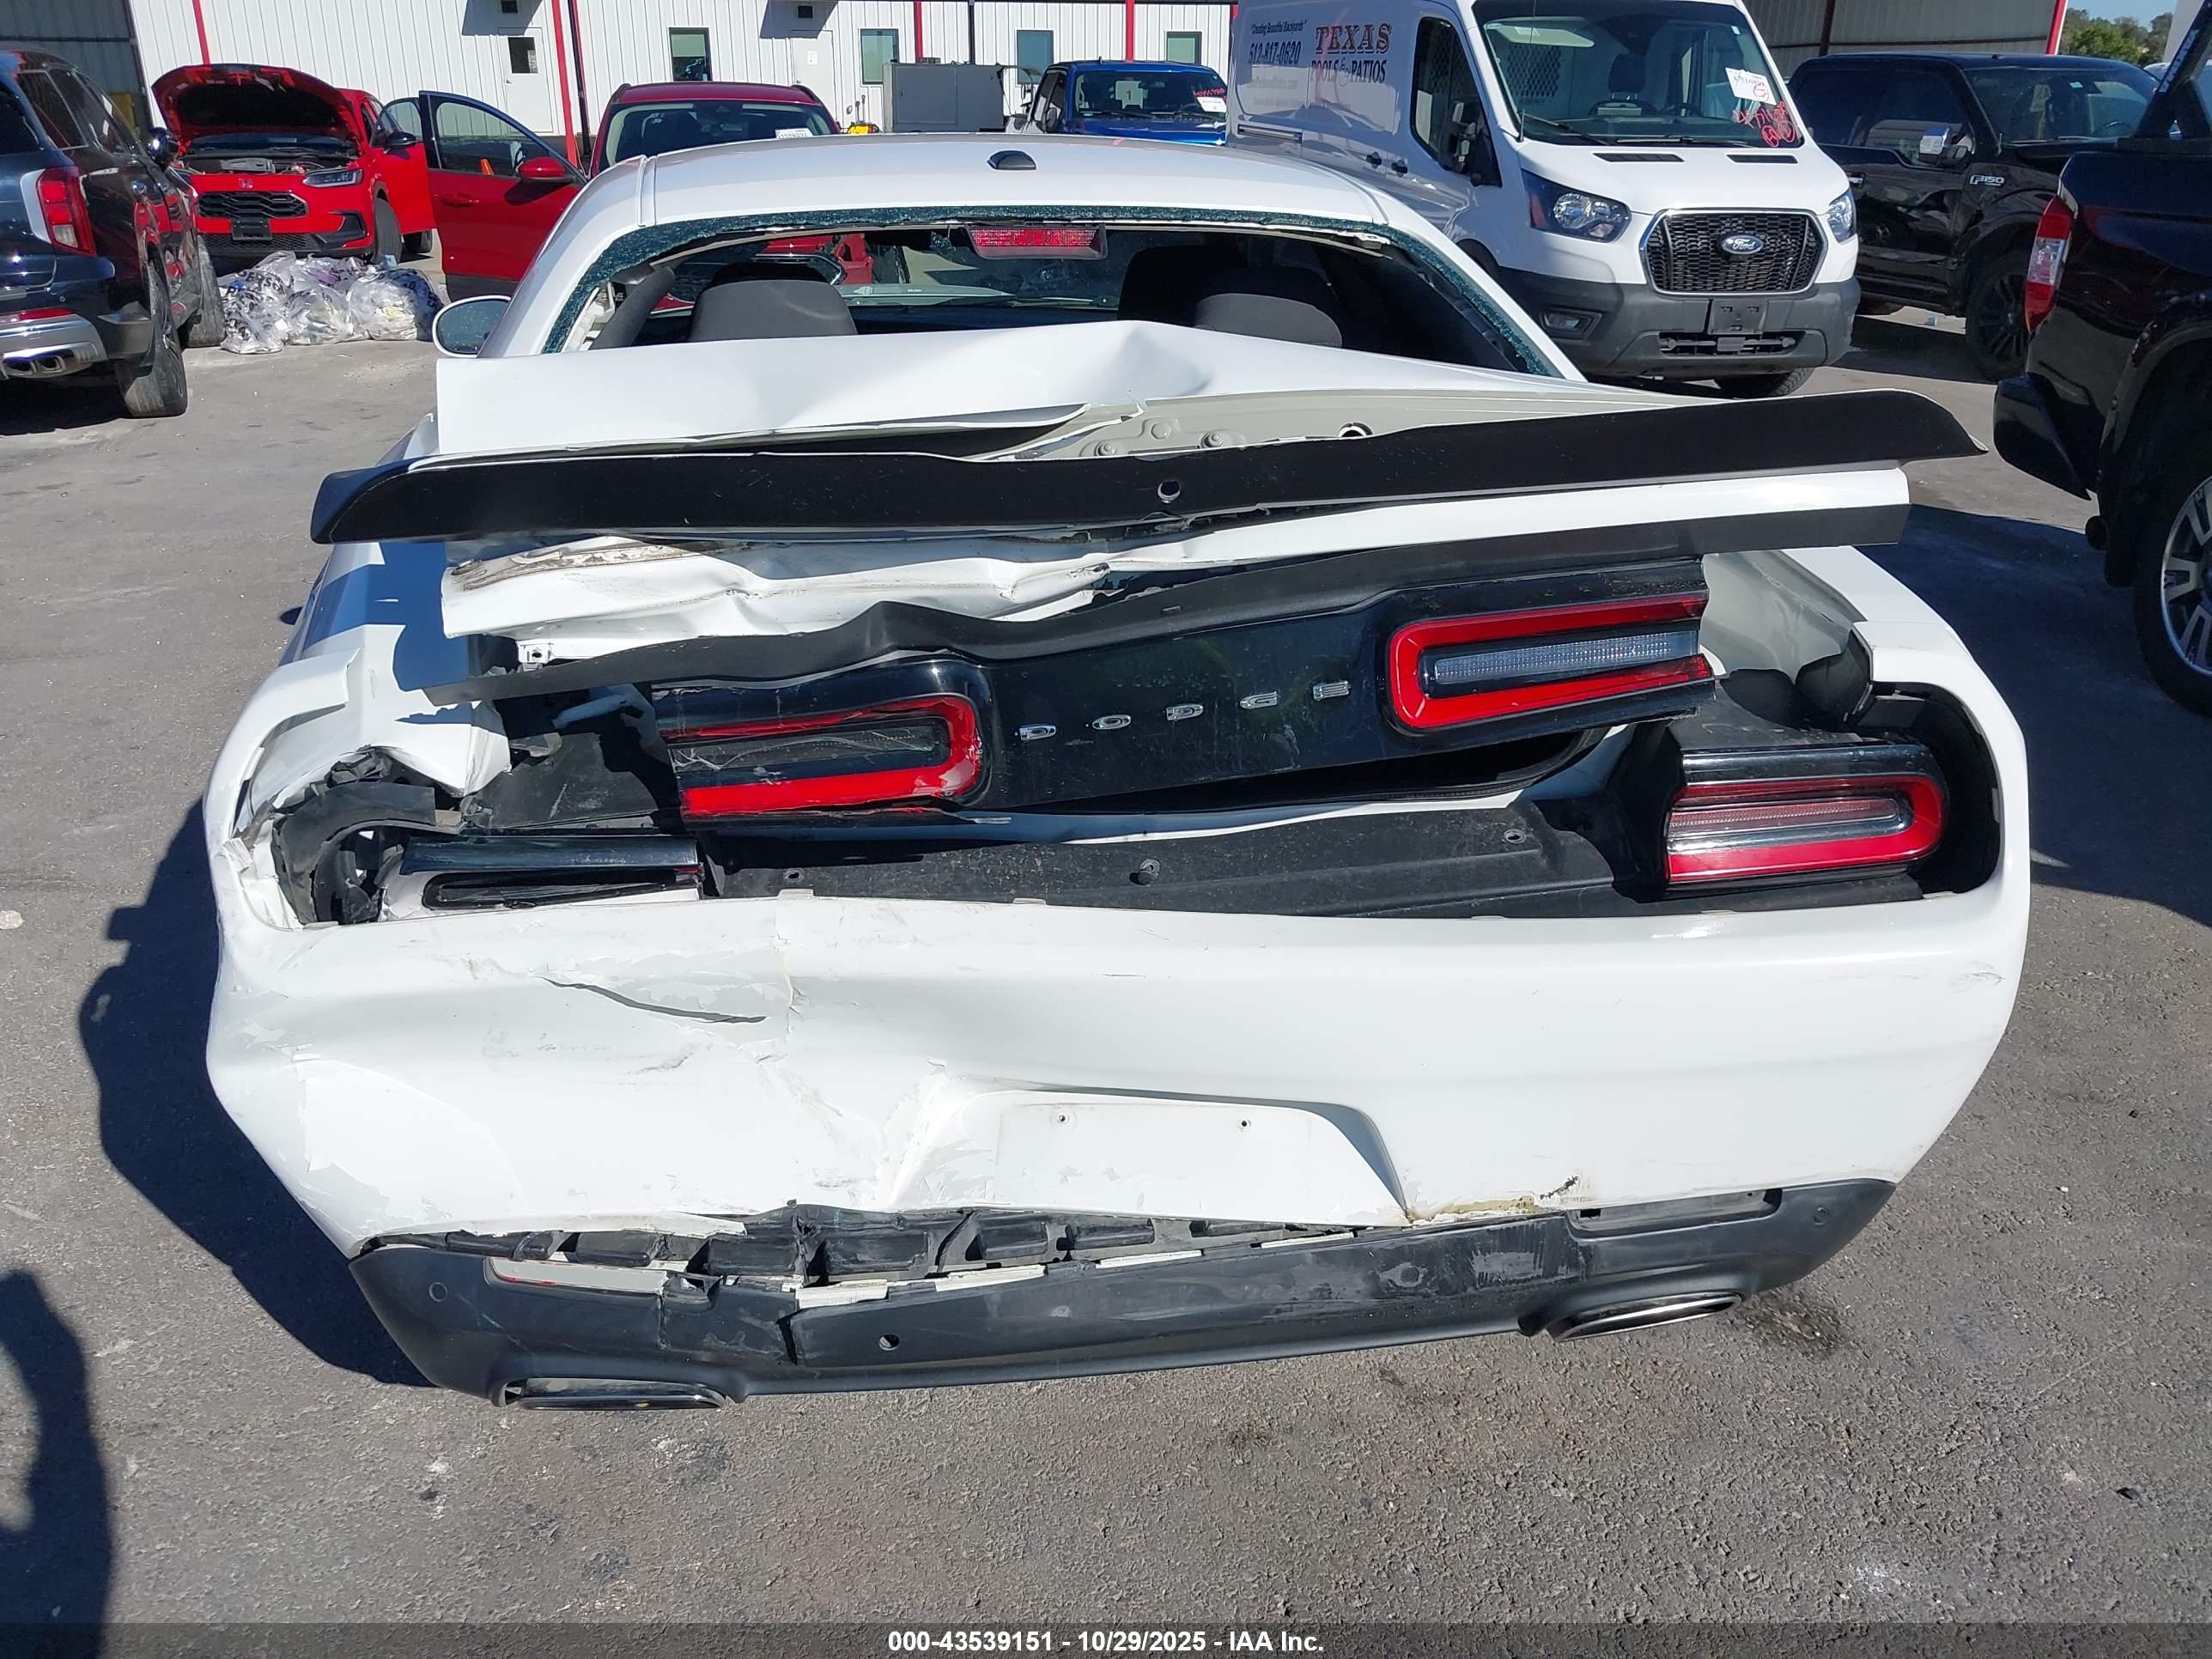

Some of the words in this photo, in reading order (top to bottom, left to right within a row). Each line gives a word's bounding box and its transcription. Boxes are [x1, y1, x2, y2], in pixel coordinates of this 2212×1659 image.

[1315, 22, 1392, 54] TEXAS
[1249, 41, 1302, 65] 512-817-0620
[1310, 59, 1339, 82] POOLS
[1350, 59, 1388, 84] PATIOS
[1732, 238, 1756, 250] Ford
[1018, 679, 1352, 742] DODGE
